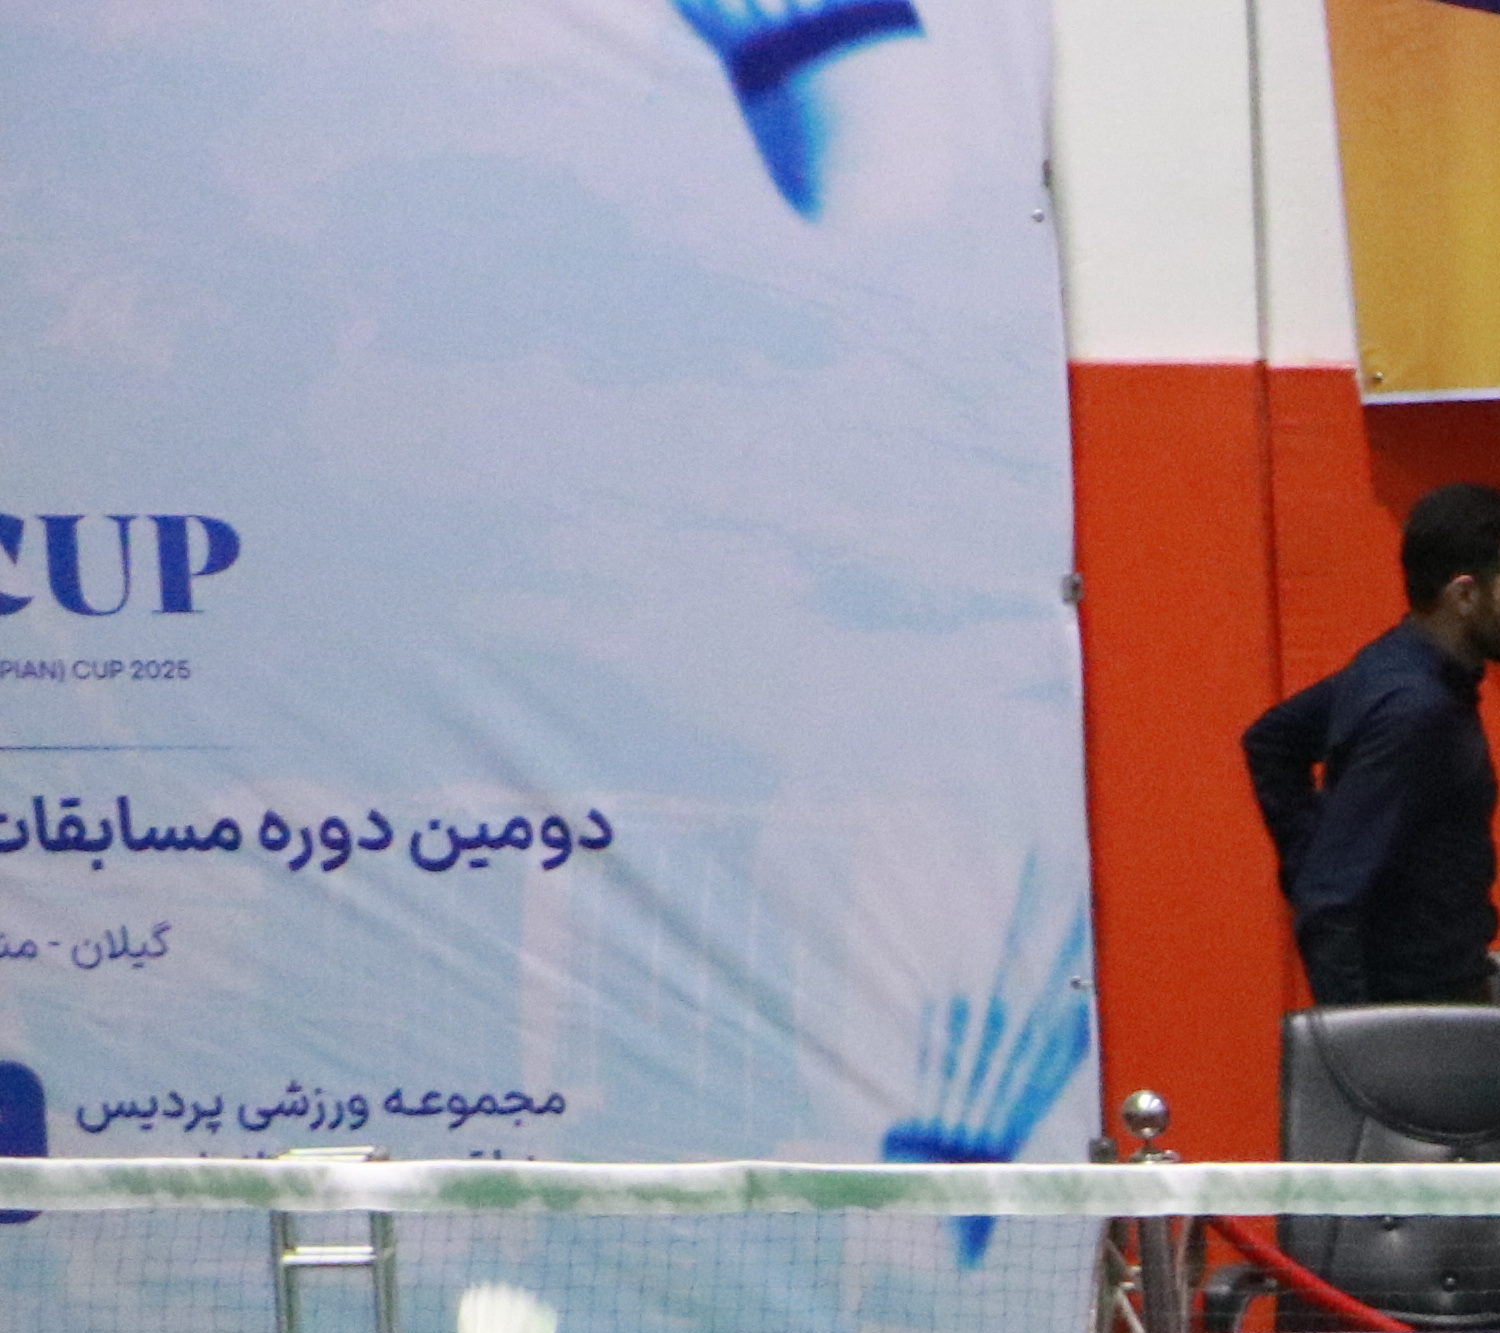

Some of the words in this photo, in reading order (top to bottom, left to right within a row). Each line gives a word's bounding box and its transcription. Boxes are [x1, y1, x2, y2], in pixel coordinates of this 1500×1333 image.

[72, 659, 125, 680] CUP
[130, 659, 193, 680] 2025
[258, 808, 394, 872] دوره
[409, 808, 614, 873] دومین
[71, 920, 173, 970] گیلان
[76, 1089, 224, 1134] پردیس
[237, 1078, 371, 1132] ورزشی
[383, 1088, 567, 1130] مجموعه
